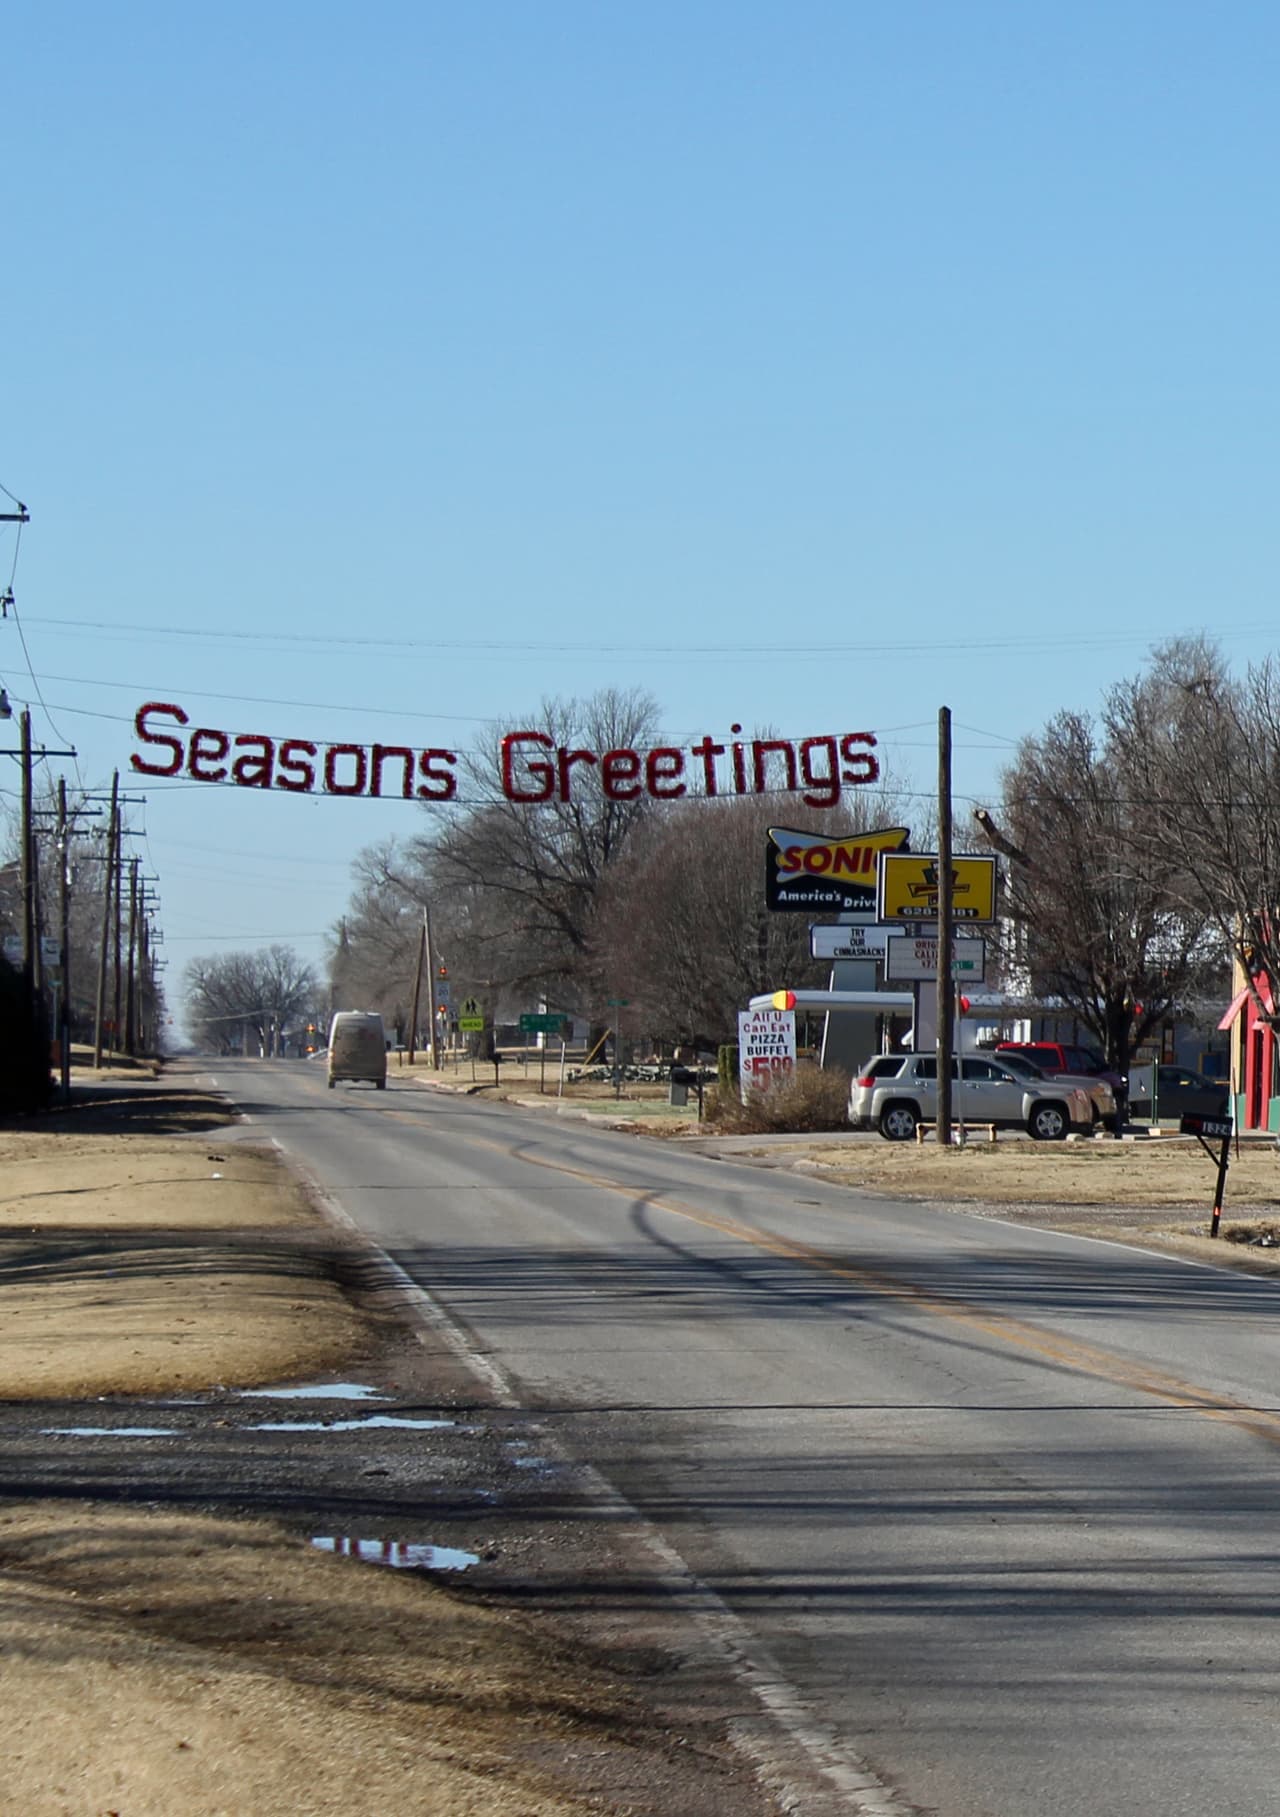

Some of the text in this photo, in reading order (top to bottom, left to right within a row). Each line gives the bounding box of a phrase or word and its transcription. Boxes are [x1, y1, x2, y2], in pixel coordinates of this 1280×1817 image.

[130, 699, 879, 808] Seasons Greetings
[777, 889, 842, 902] America's
[851, 928, 865, 937] TRY
[850, 938, 865, 946] OUR
[752, 1012, 782, 1023] All U
[743, 1023, 791, 1033] Can Eat
[750, 1034, 785, 1044] PIZZA
[747, 1045, 789, 1056] BUFFET
